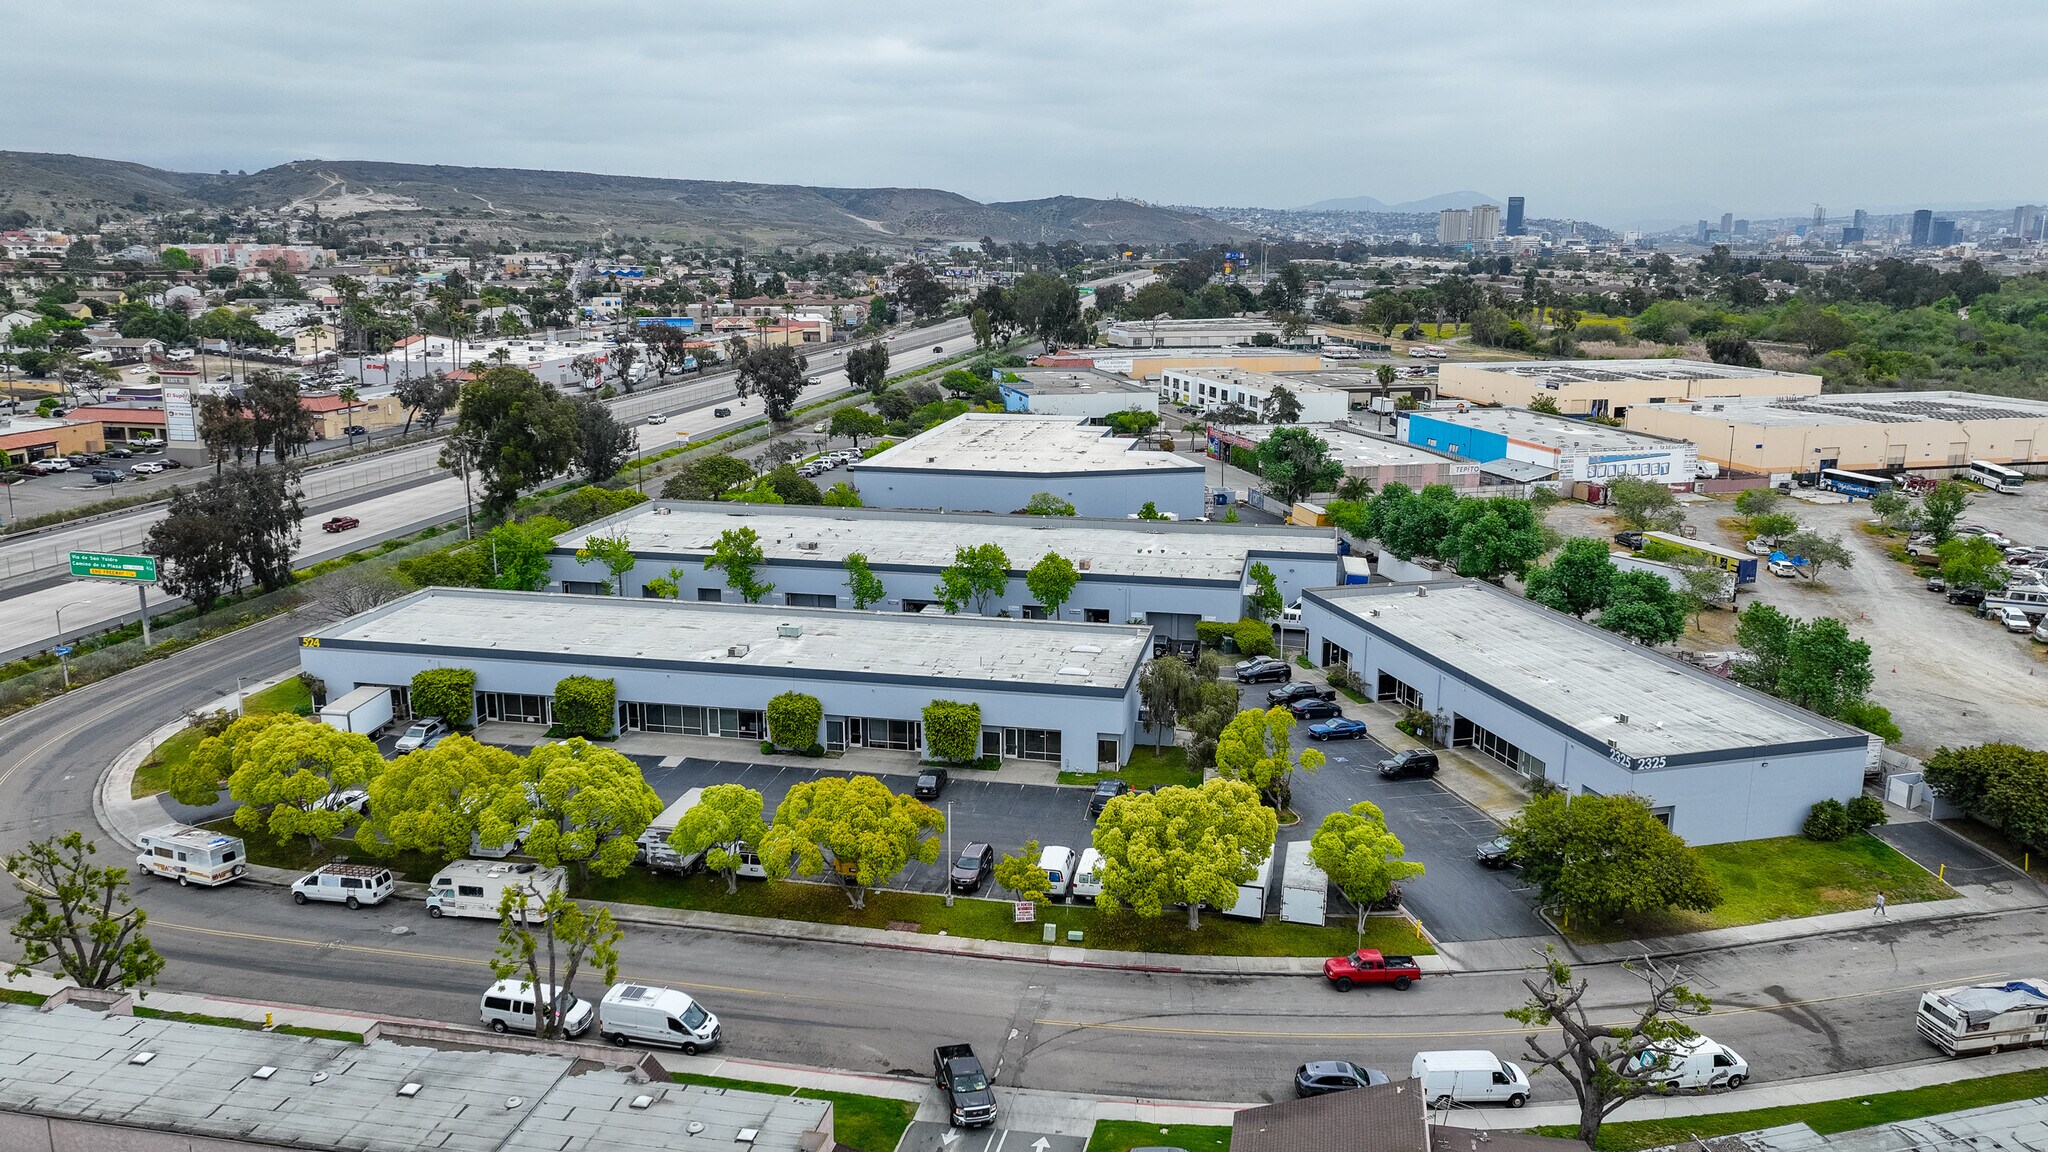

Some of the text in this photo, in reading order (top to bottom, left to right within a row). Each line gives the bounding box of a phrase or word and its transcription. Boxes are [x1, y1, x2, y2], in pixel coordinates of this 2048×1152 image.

[303, 637, 320, 648] 524
[1609, 748, 1632, 768] 2325
[1637, 756, 1667, 770] 2325
